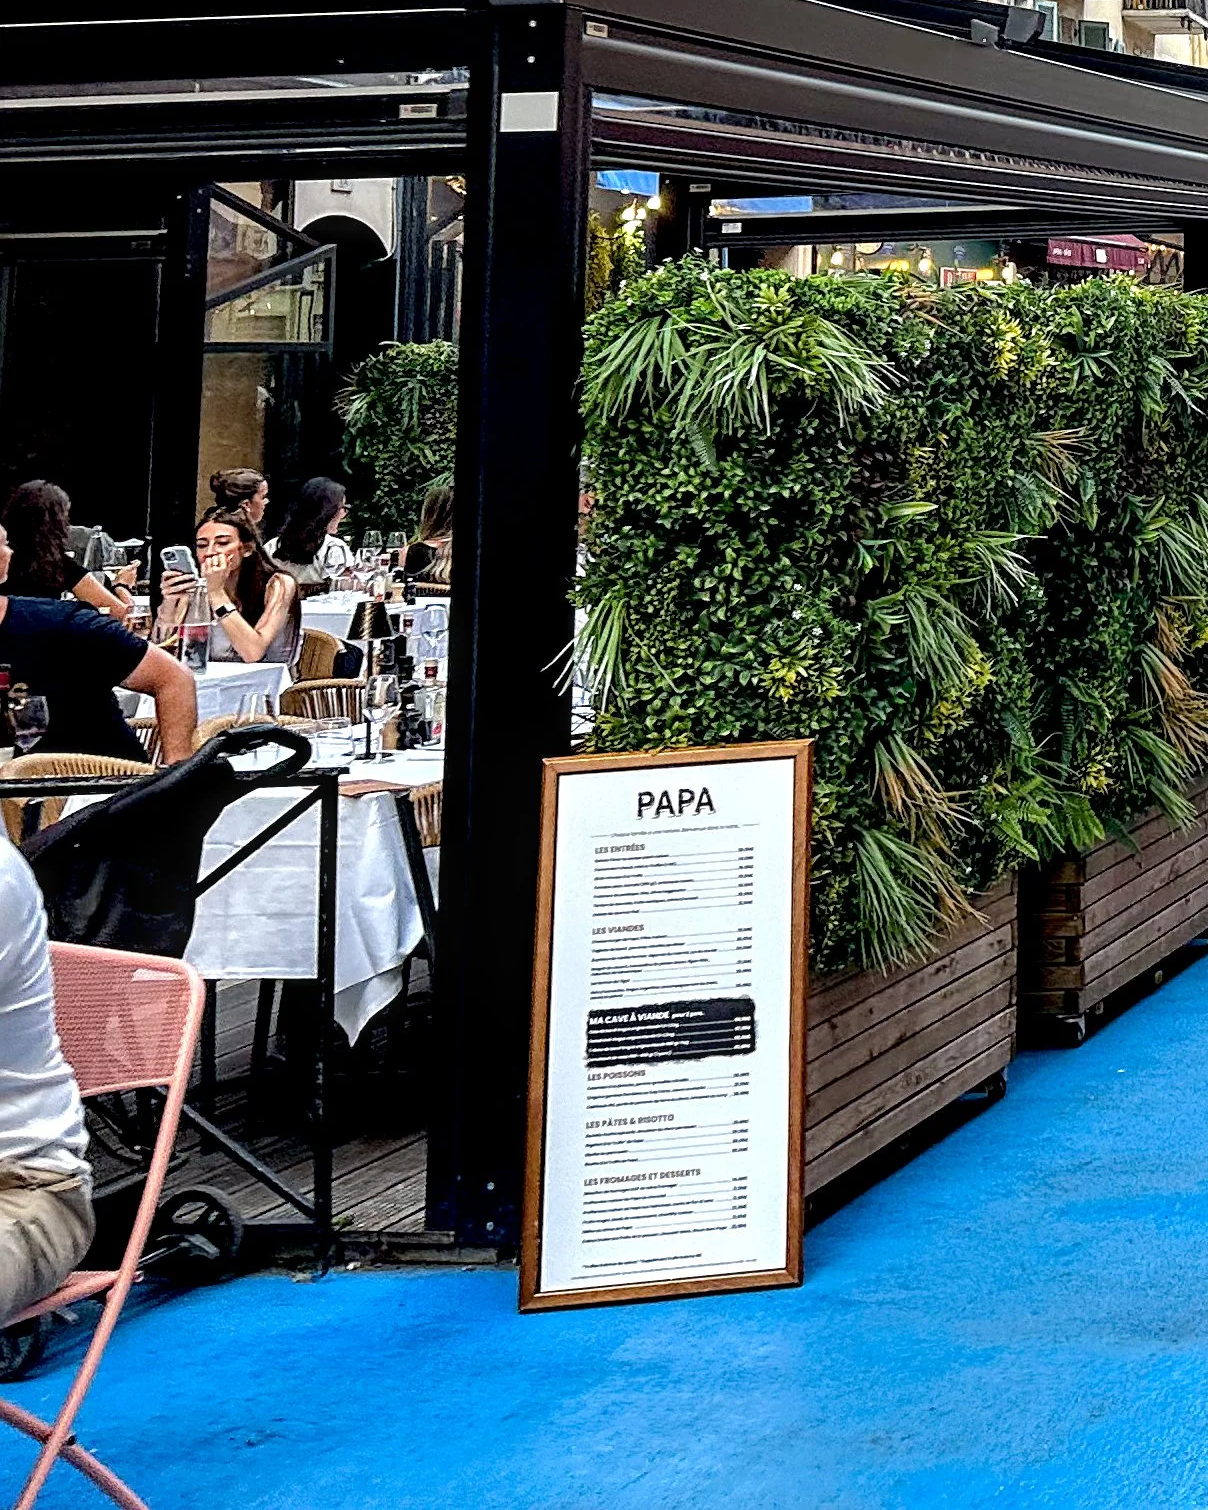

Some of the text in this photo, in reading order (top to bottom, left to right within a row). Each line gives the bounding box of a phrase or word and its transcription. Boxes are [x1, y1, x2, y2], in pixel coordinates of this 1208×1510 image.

[636, 786, 717, 820] PAPA
[594, 843, 646, 854] LES ENTRÉES
[591, 924, 645, 936] LES VIANDES
[589, 1016, 603, 1025] MA
[604, 1013, 629, 1024] CAVE
[636, 1011, 671, 1022] VIANDE
[587, 1069, 647, 1081] LES POISSONS
[585, 1121, 600, 1129] LES
[601, 1117, 628, 1127] PÂTES
[637, 1113, 675, 1124] RISOTTO
[584, 1168, 702, 1186] LES FROMAGES ET DESSERTS
